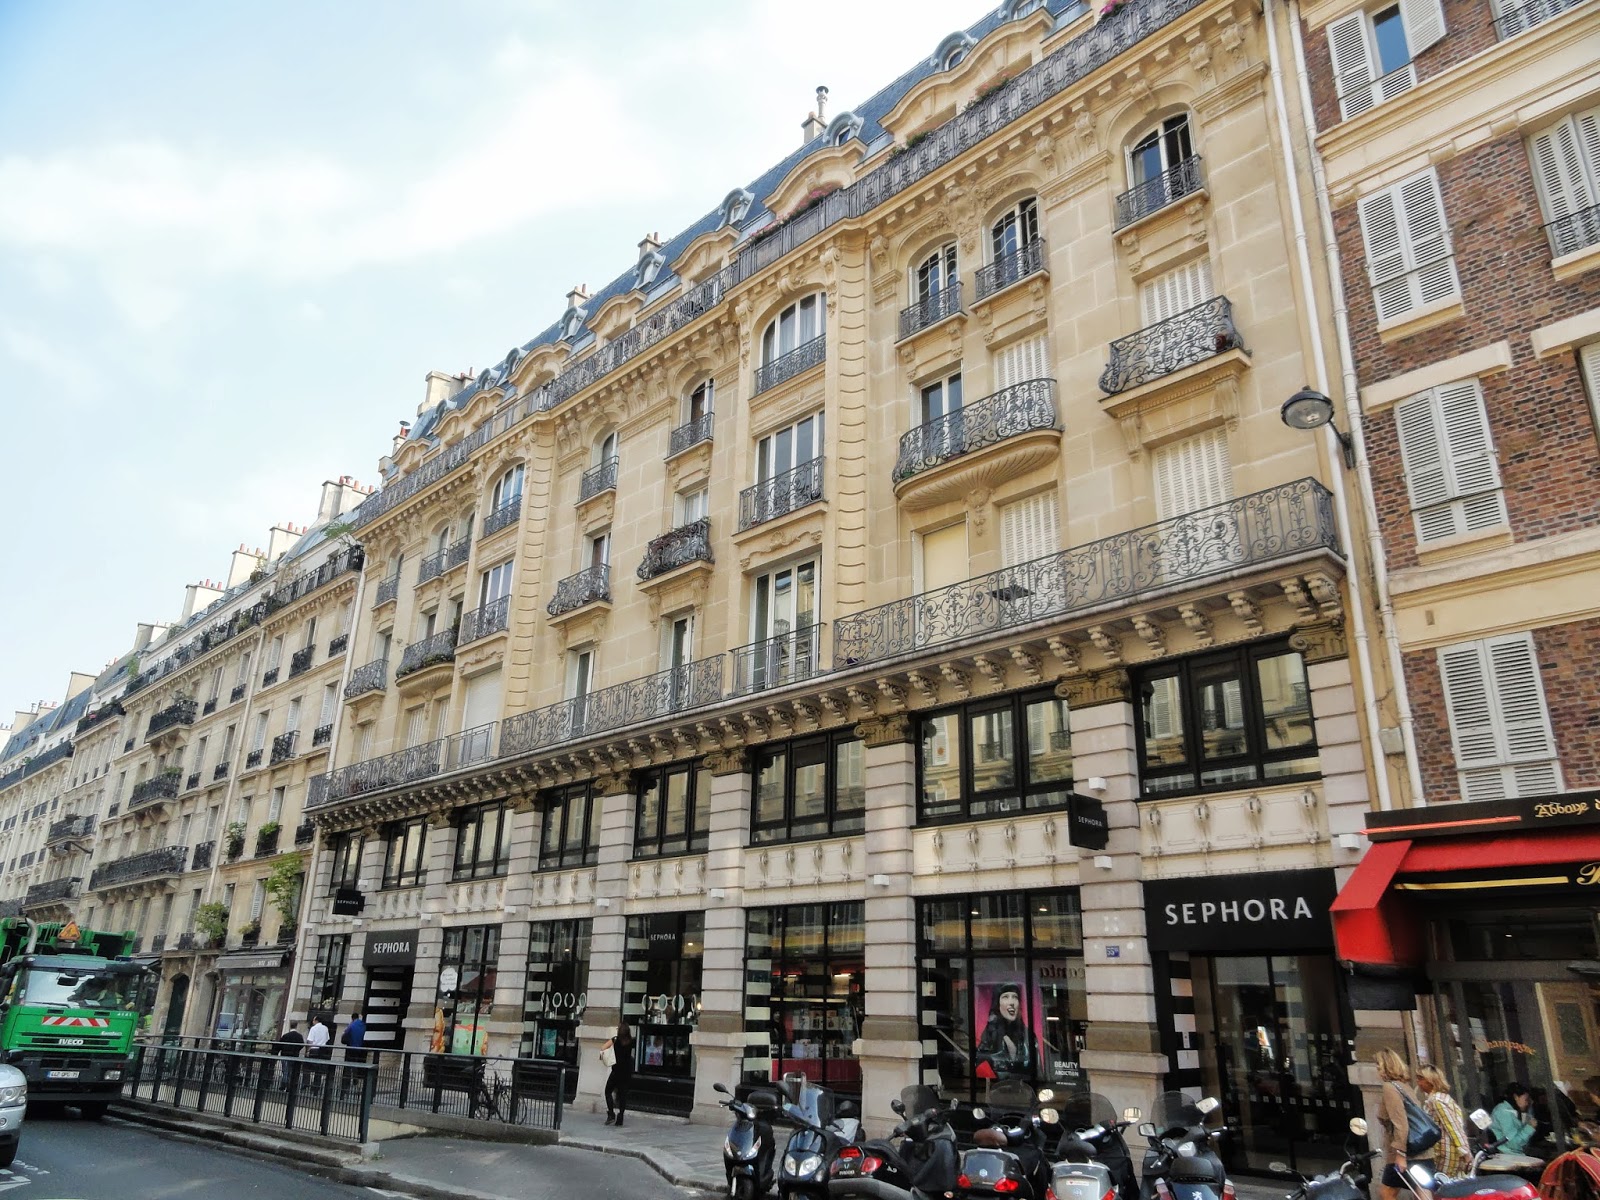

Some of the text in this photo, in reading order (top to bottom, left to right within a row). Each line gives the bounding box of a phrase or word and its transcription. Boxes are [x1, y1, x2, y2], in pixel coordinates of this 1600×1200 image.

[1534, 801, 1590, 818] Abbaye
[1077, 815, 1103, 828] SEPHORA
[1165, 896, 1313, 926] SEPHORA
[650, 933, 676, 941] SEPHORA
[373, 941, 410, 954] SEPHORA
[58, 1038, 84, 1046] IVECO
[1054, 1061, 1078, 1069] BEAUTY
